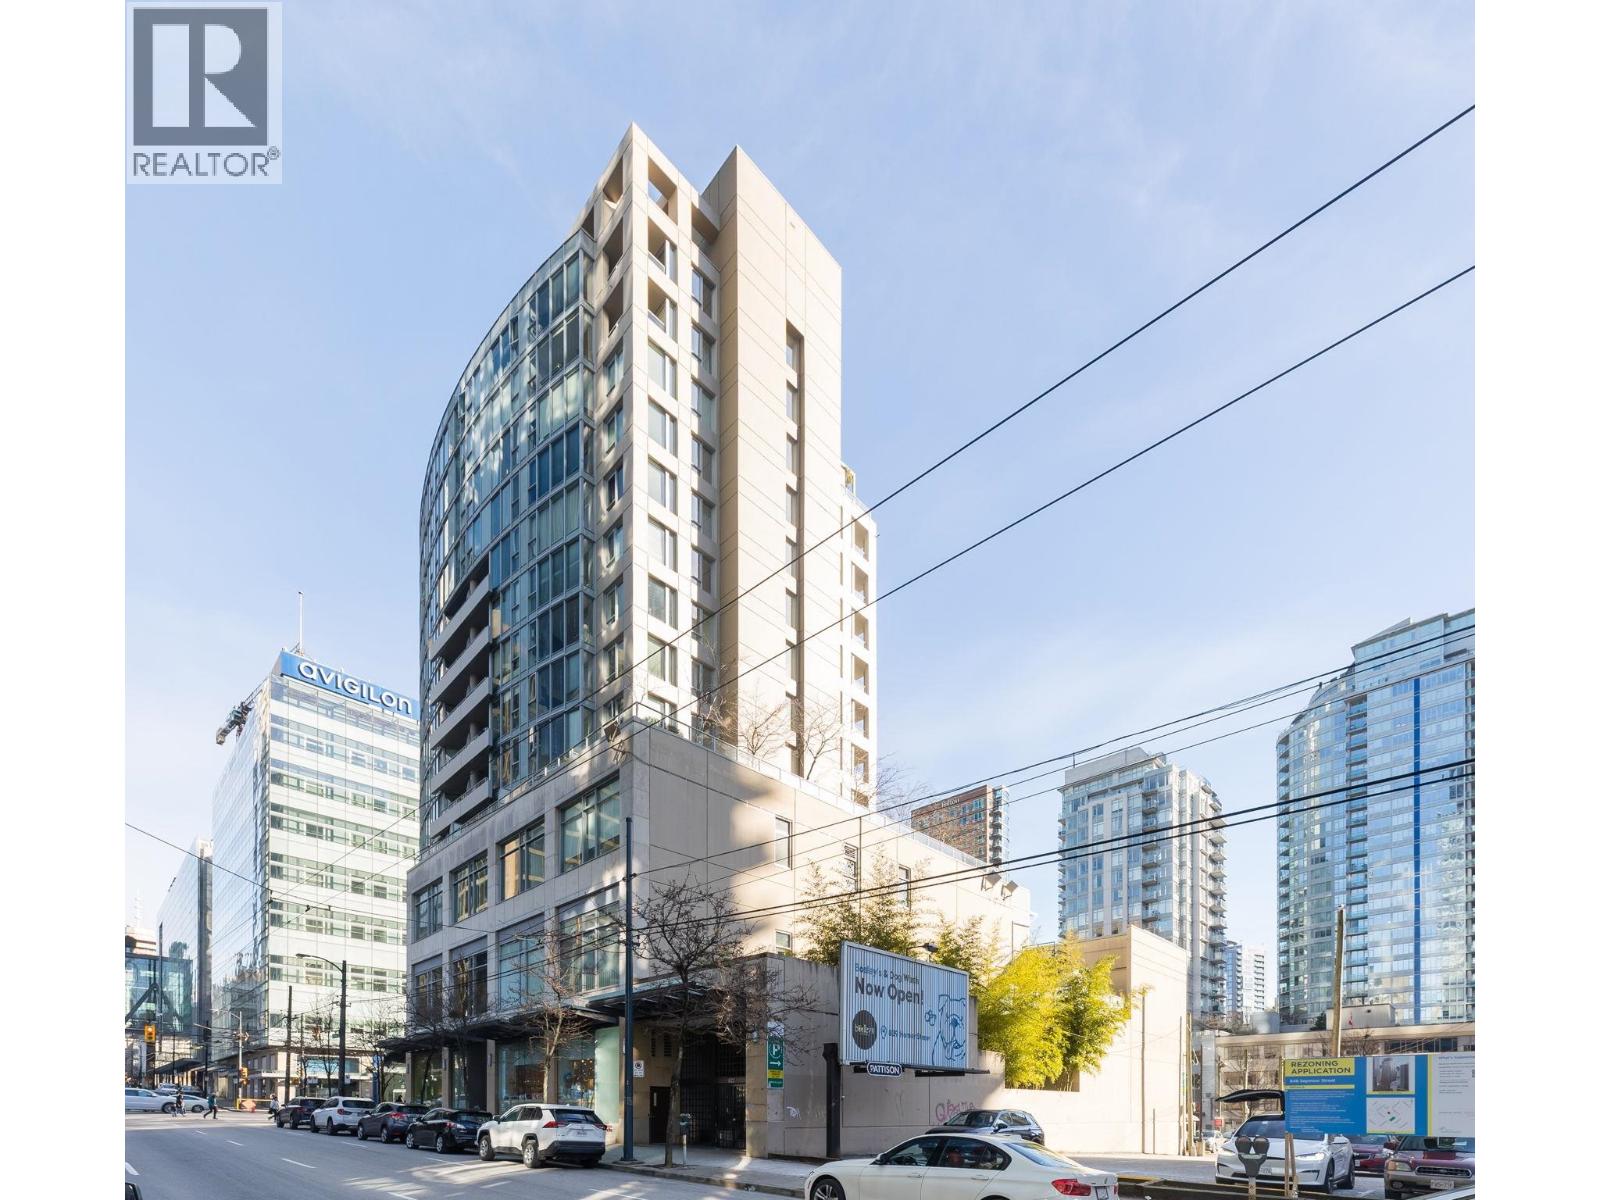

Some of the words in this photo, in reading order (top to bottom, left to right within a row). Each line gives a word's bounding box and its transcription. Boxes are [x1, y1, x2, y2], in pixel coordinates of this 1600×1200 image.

[855, 976, 885, 998] Now
[887, 983, 924, 1005] Open!
[870, 1064, 900, 1075] PATTISON
